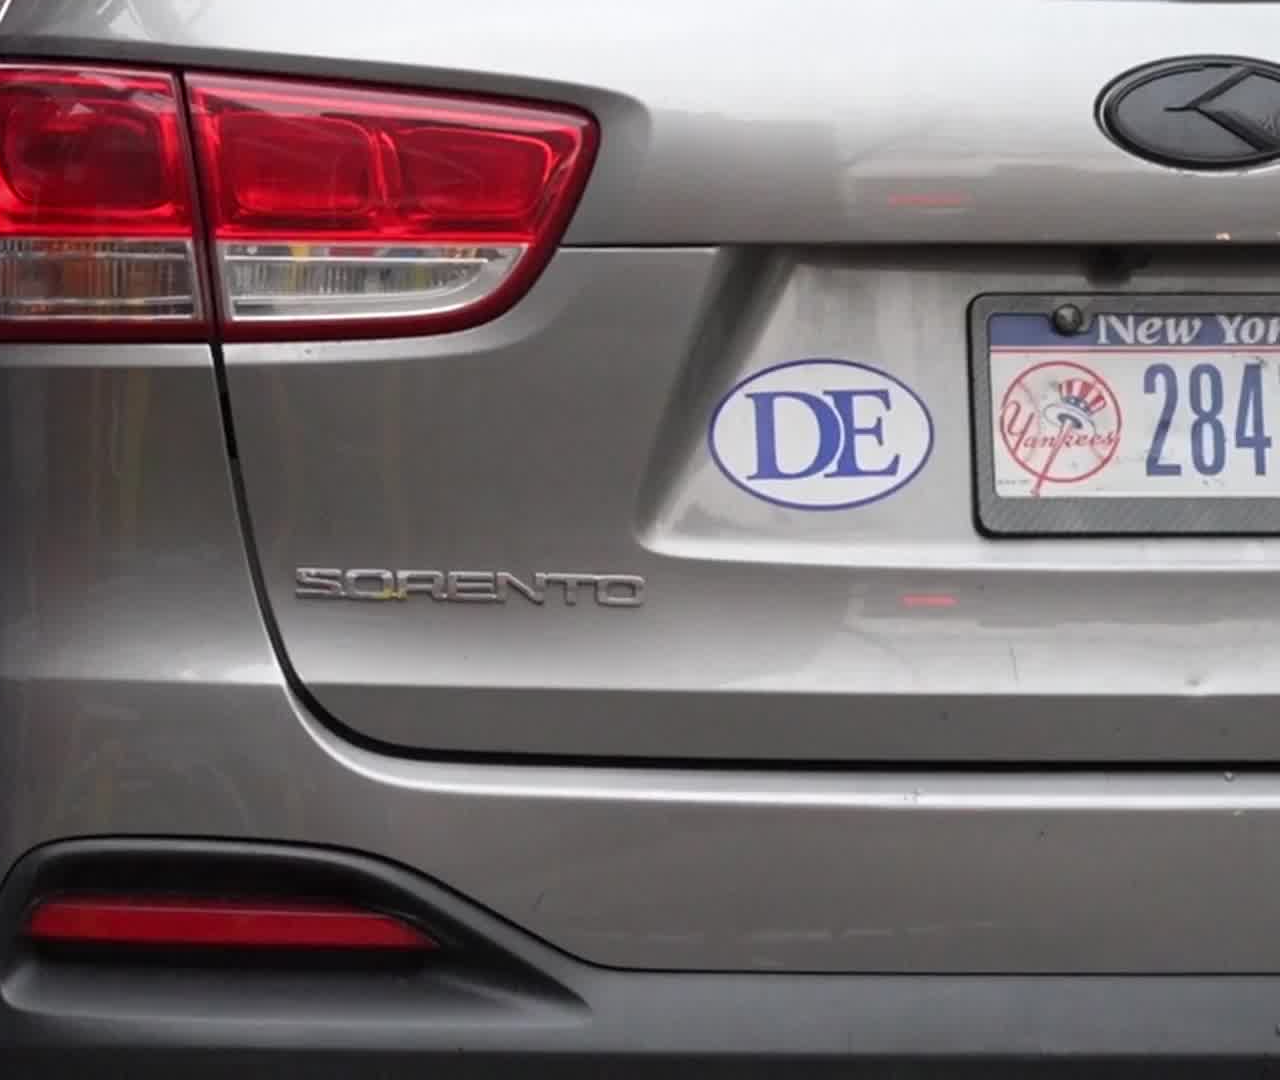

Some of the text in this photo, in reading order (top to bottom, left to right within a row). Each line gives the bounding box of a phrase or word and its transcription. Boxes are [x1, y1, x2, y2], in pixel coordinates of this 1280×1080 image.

[1096, 314, 1203, 346] New
[746, 387, 901, 481] DE
[1002, 400, 1118, 452] Yankees
[294, 567, 648, 608] SORENTO
